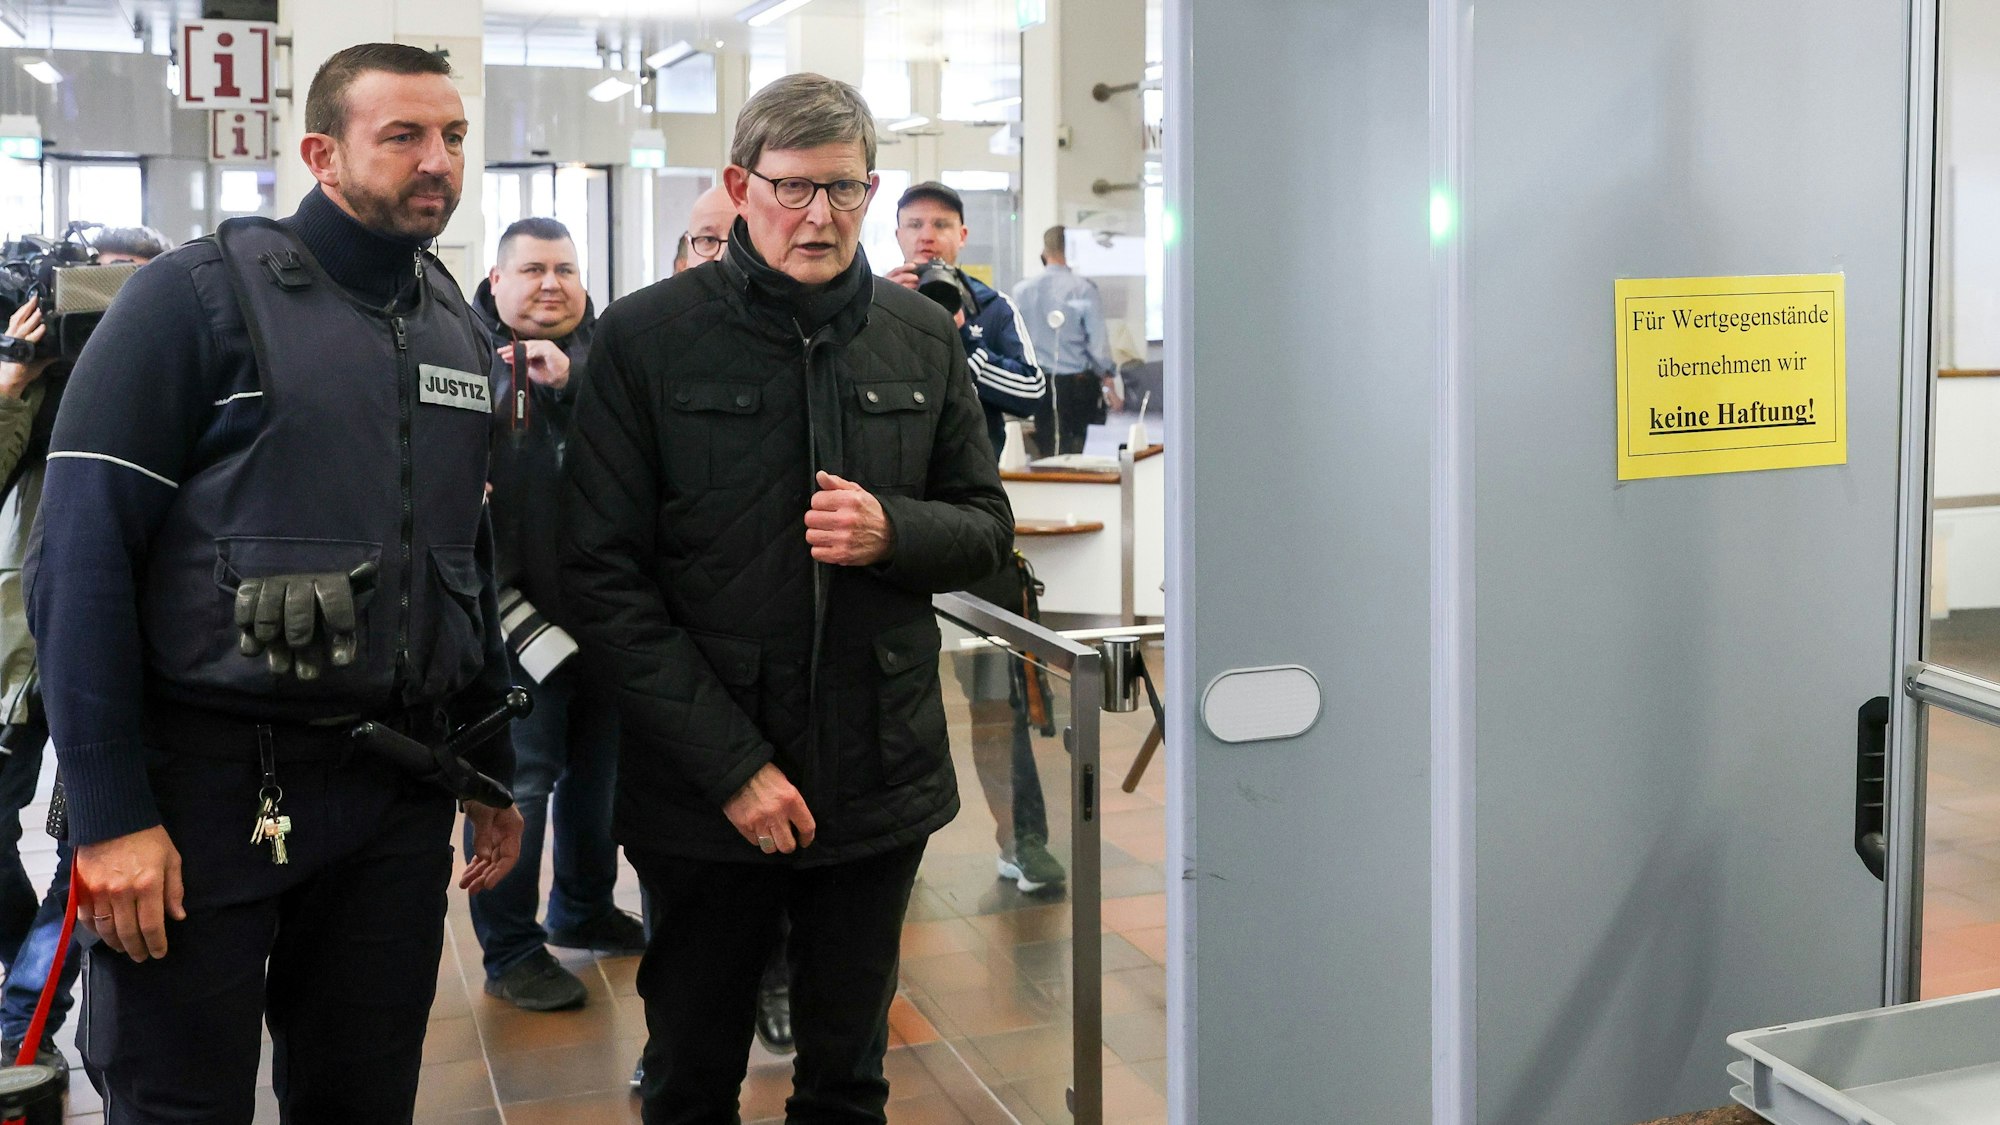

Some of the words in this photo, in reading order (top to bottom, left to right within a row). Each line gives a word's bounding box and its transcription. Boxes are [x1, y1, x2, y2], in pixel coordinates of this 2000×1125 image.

[1632, 311, 1665, 331] Für
[1672, 304, 1829, 333] Wertgegenstände
[1658, 354, 1771, 378] übernehmen
[1777, 351, 1807, 371] wir
[425, 376, 486, 401] JUSTIZ
[1649, 406, 1710, 433] keine
[1717, 398, 1815, 427] Haftung!
